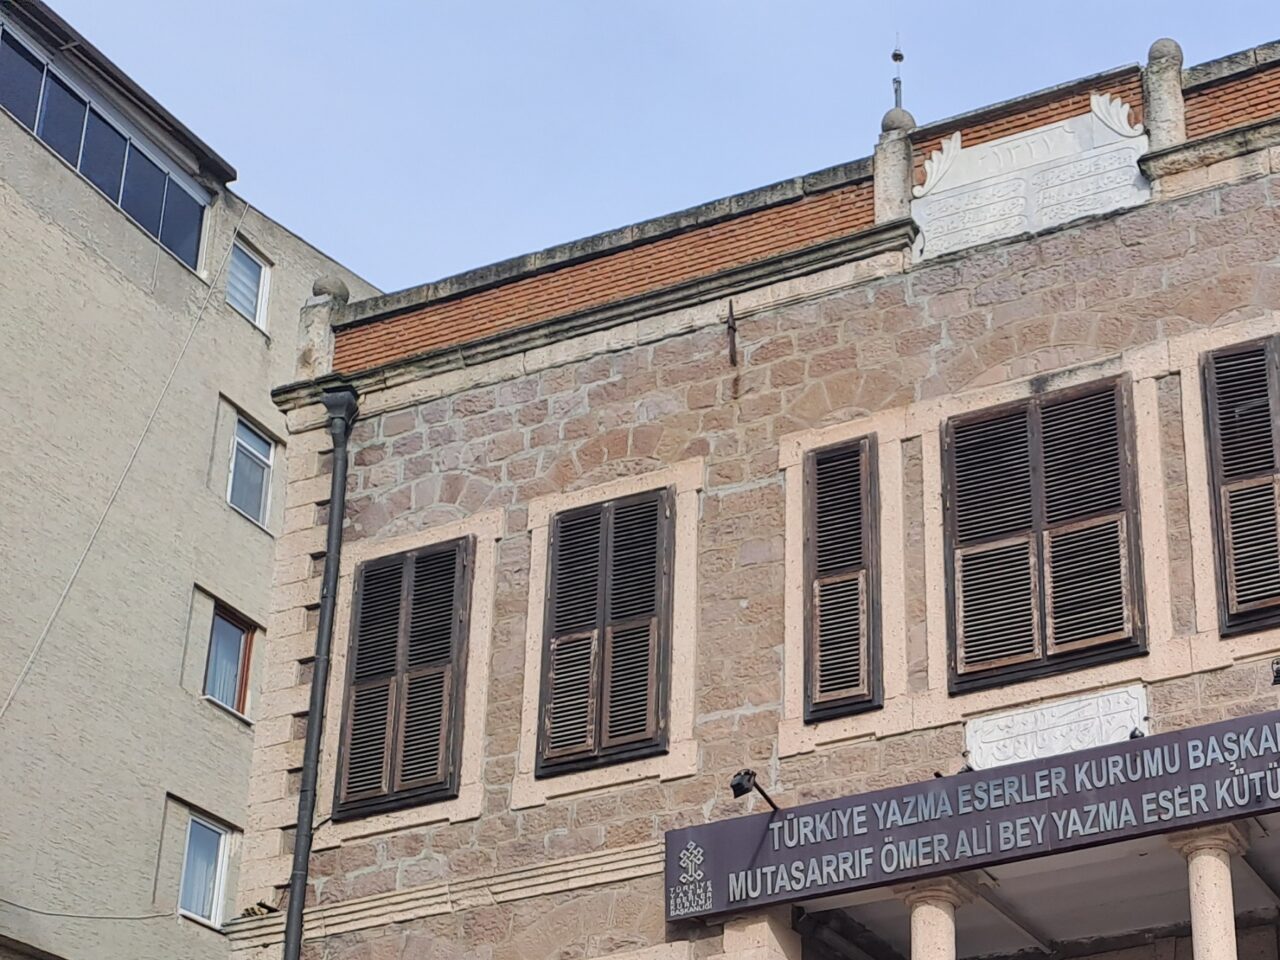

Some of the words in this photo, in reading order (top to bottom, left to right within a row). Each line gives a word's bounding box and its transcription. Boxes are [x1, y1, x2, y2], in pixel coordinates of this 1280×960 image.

[871, 789, 953, 830] YAZMA
[958, 766, 1068, 815] ESERLER
[1074, 742, 1180, 792] KURUMU
[728, 847, 874, 902] MUTASARRIF
[880, 833, 950, 874] ÖMER
[954, 820, 992, 860] ALİ
[998, 814, 1047, 852] BEY
[1051, 798, 1138, 840] YAZMA
[1142, 783, 1209, 824] ESER
